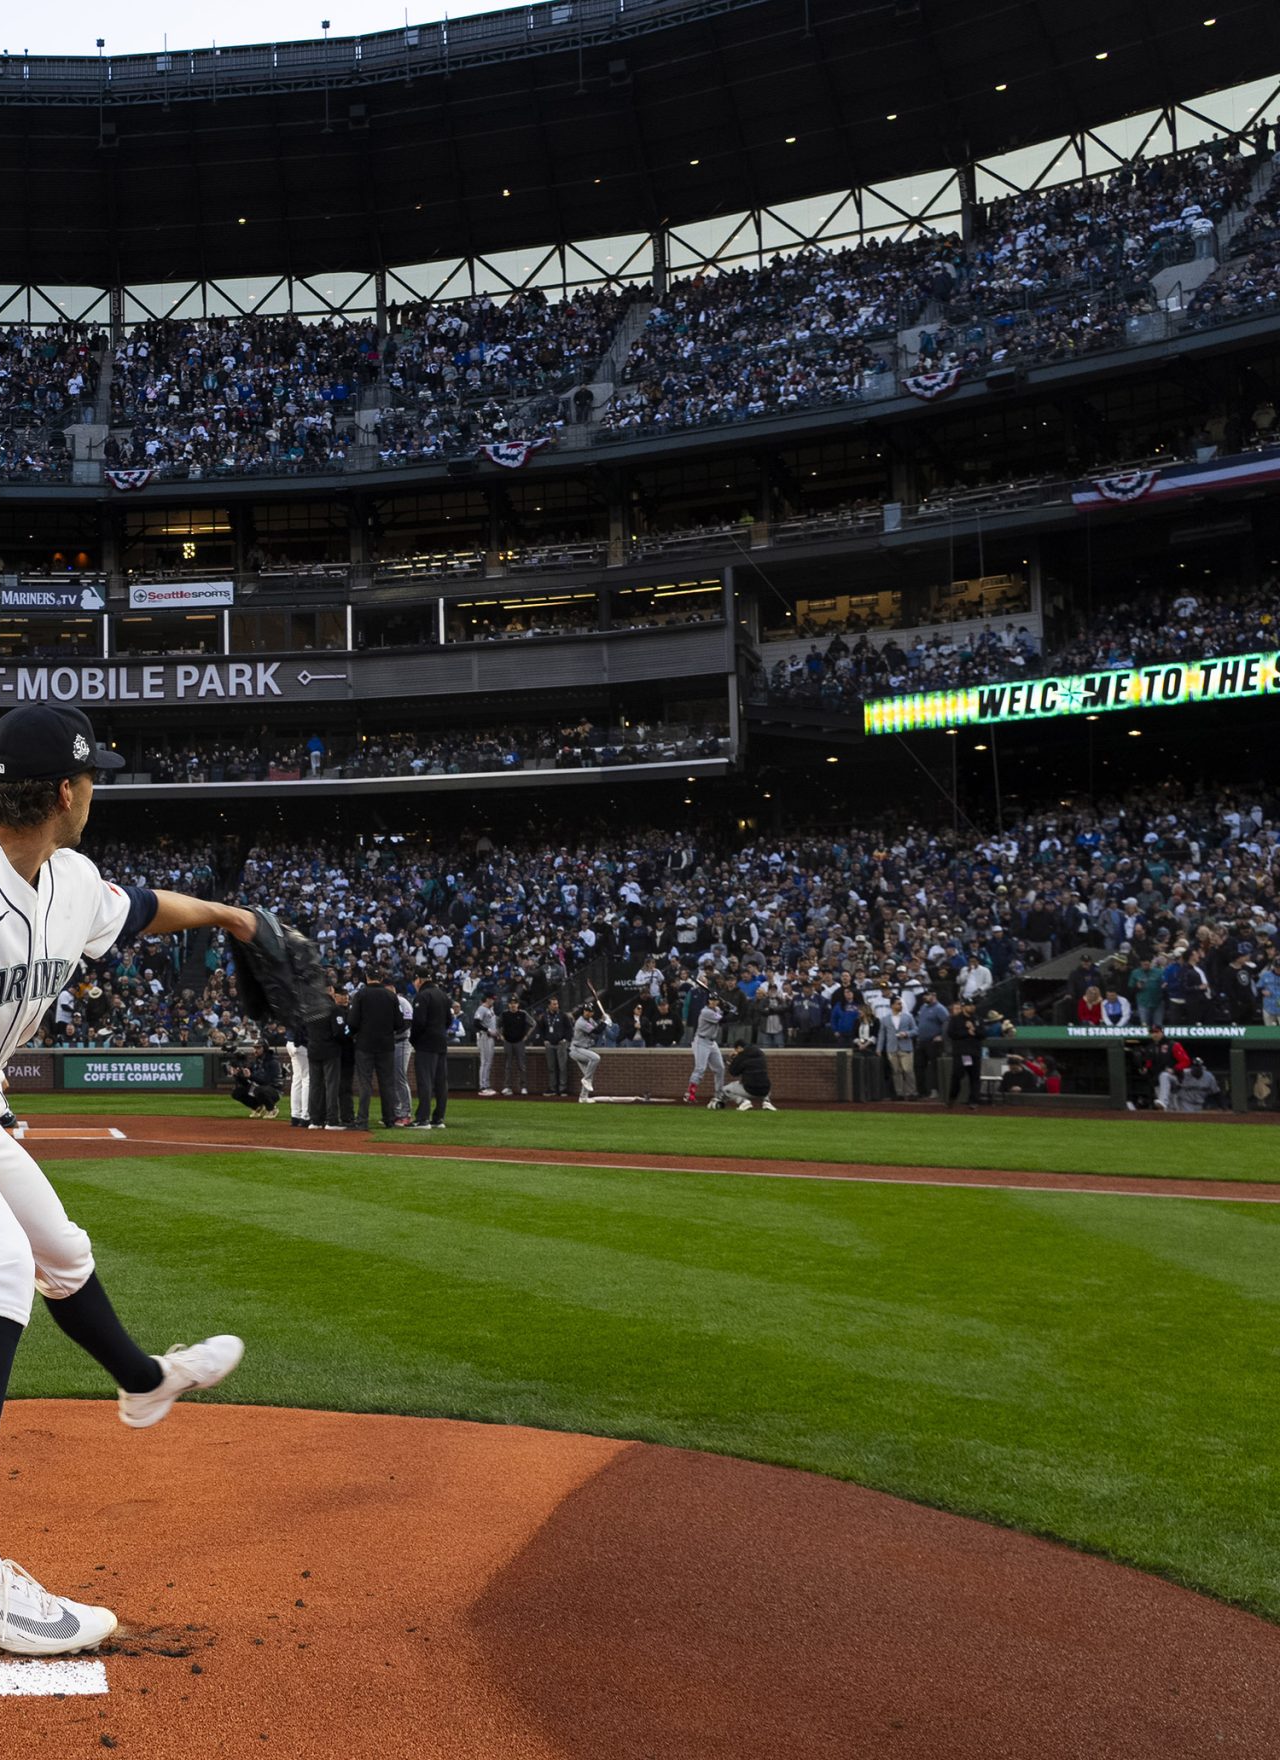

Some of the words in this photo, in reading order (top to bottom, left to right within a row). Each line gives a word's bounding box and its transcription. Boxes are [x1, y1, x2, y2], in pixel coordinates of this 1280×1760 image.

[176, 661, 283, 698] PARK
[1143, 666, 1185, 704] TO
[1199, 657, 1261, 700] THE
[1067, 1027, 1087, 1036] THE
[1087, 1027, 1148, 1037] STARBUCKS
[1189, 1027, 1246, 1036] COMPANY
[7, 1065, 41, 1077] PARK
[86, 1063, 109, 1072] THE
[110, 1062, 182, 1072] STARBUCKS
[84, 1072, 125, 1082] COFFEE
[126, 1072, 184, 1082] COMPANY
